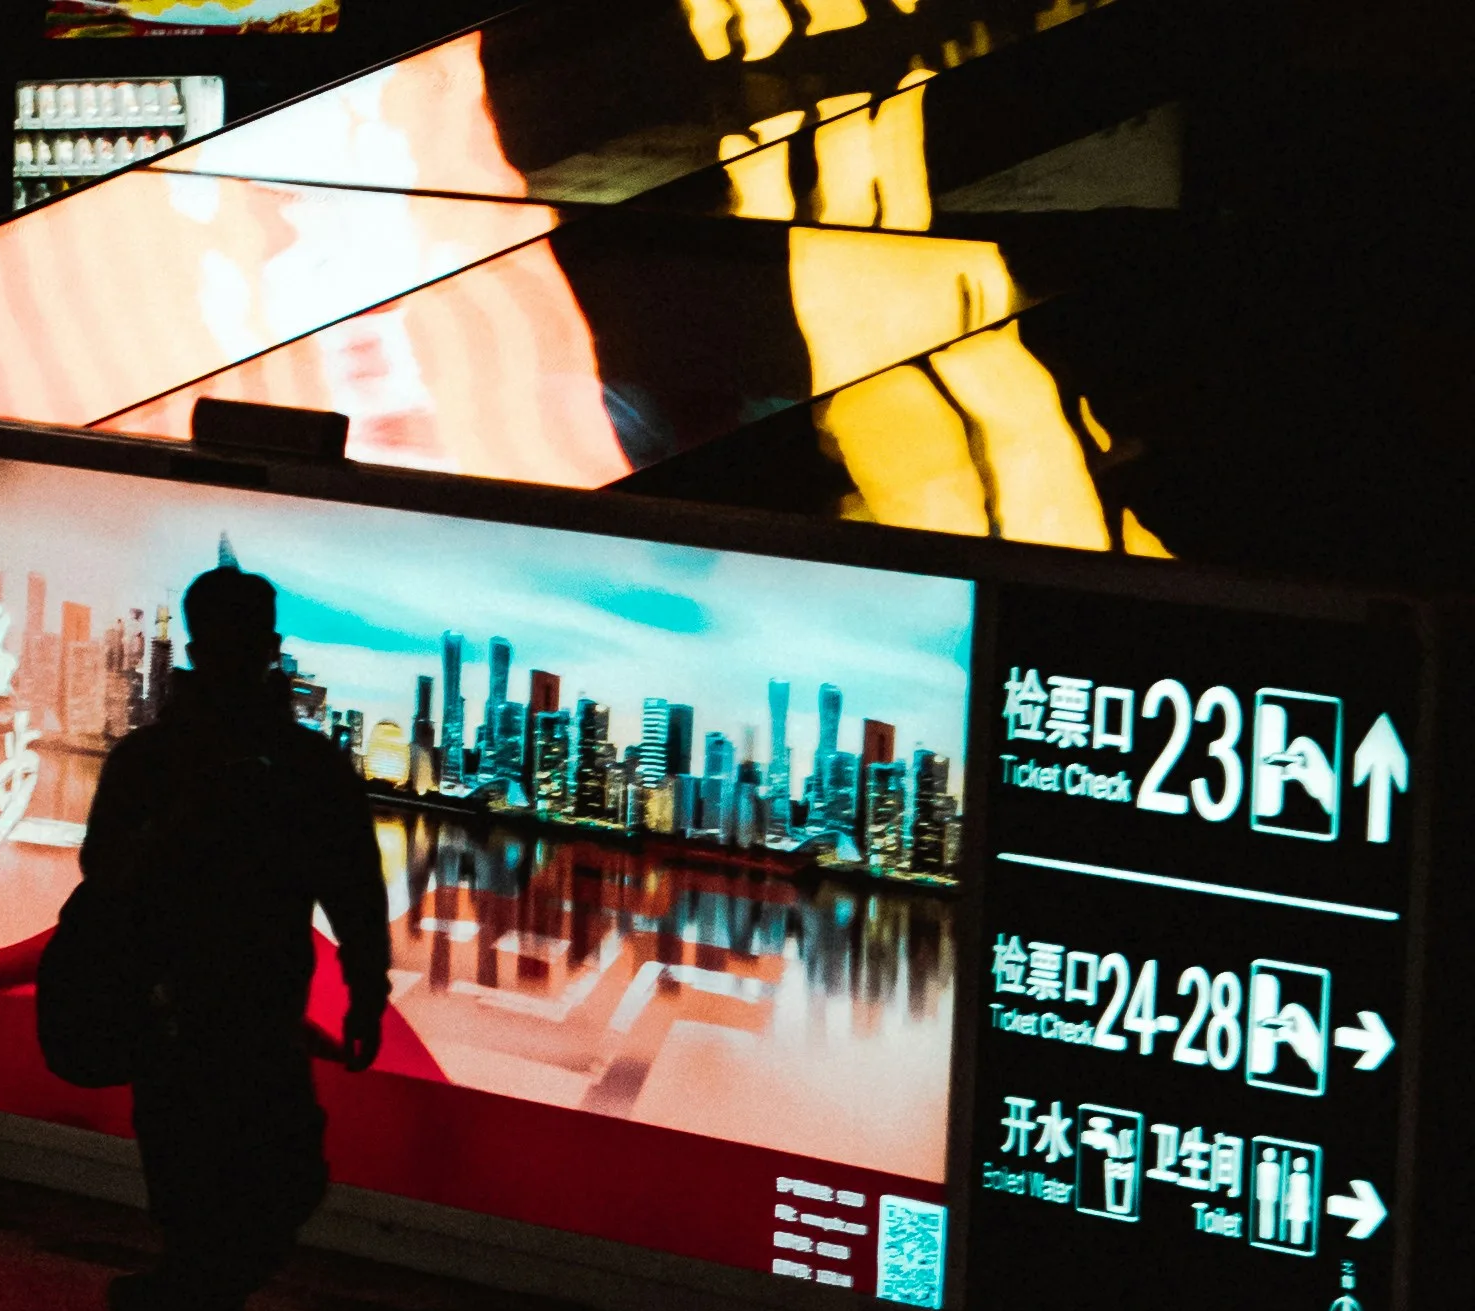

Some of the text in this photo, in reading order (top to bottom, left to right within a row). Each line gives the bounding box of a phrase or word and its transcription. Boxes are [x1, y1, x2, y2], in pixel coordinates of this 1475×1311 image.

[999, 754, 1132, 803] Ticket Check
[1002, 666, 1244, 822] 检票口 23
[988, 1003, 1095, 1046] Ticket Check
[991, 932, 1242, 1071] 检票口 24-28
[1000, 1096, 1244, 1198] 开水 卫生间
